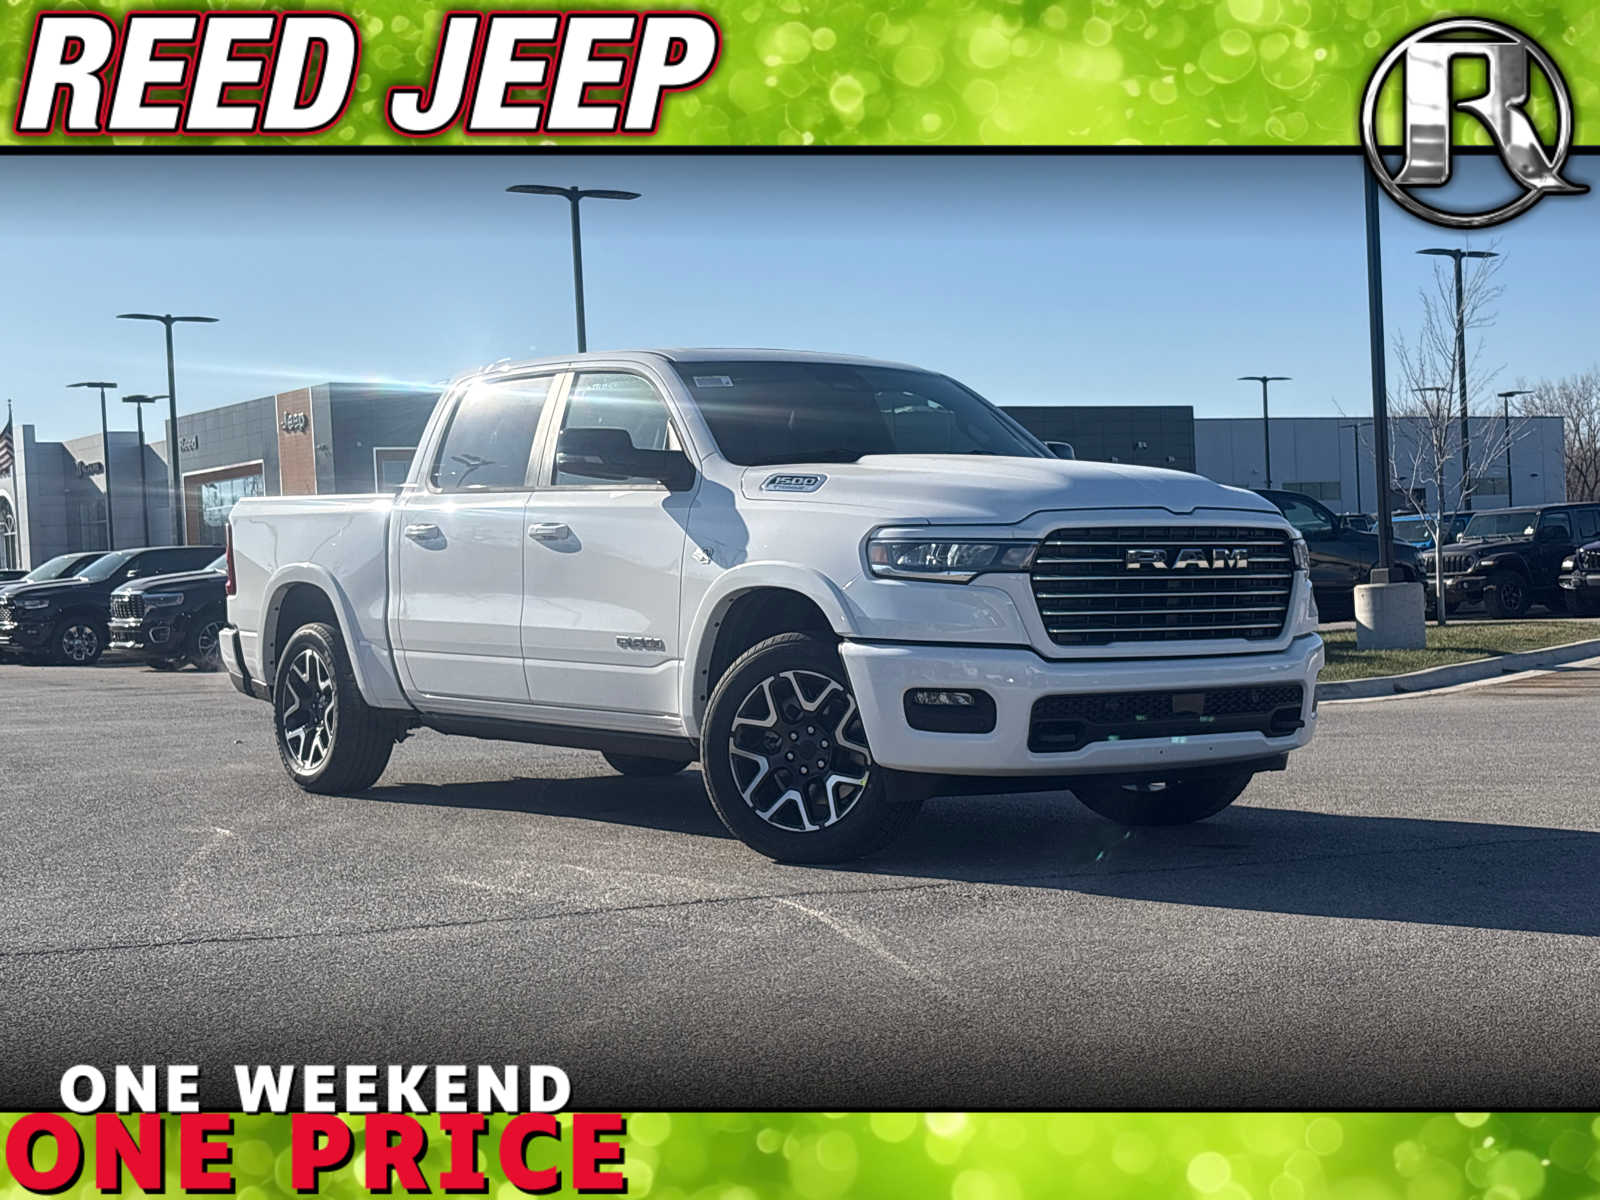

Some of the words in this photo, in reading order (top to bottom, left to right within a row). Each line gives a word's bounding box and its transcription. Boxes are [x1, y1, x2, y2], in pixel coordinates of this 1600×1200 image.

[281, 411, 307, 433] Jeep
[775, 476, 816, 485] 1500
[1127, 548, 1248, 569] RAM
